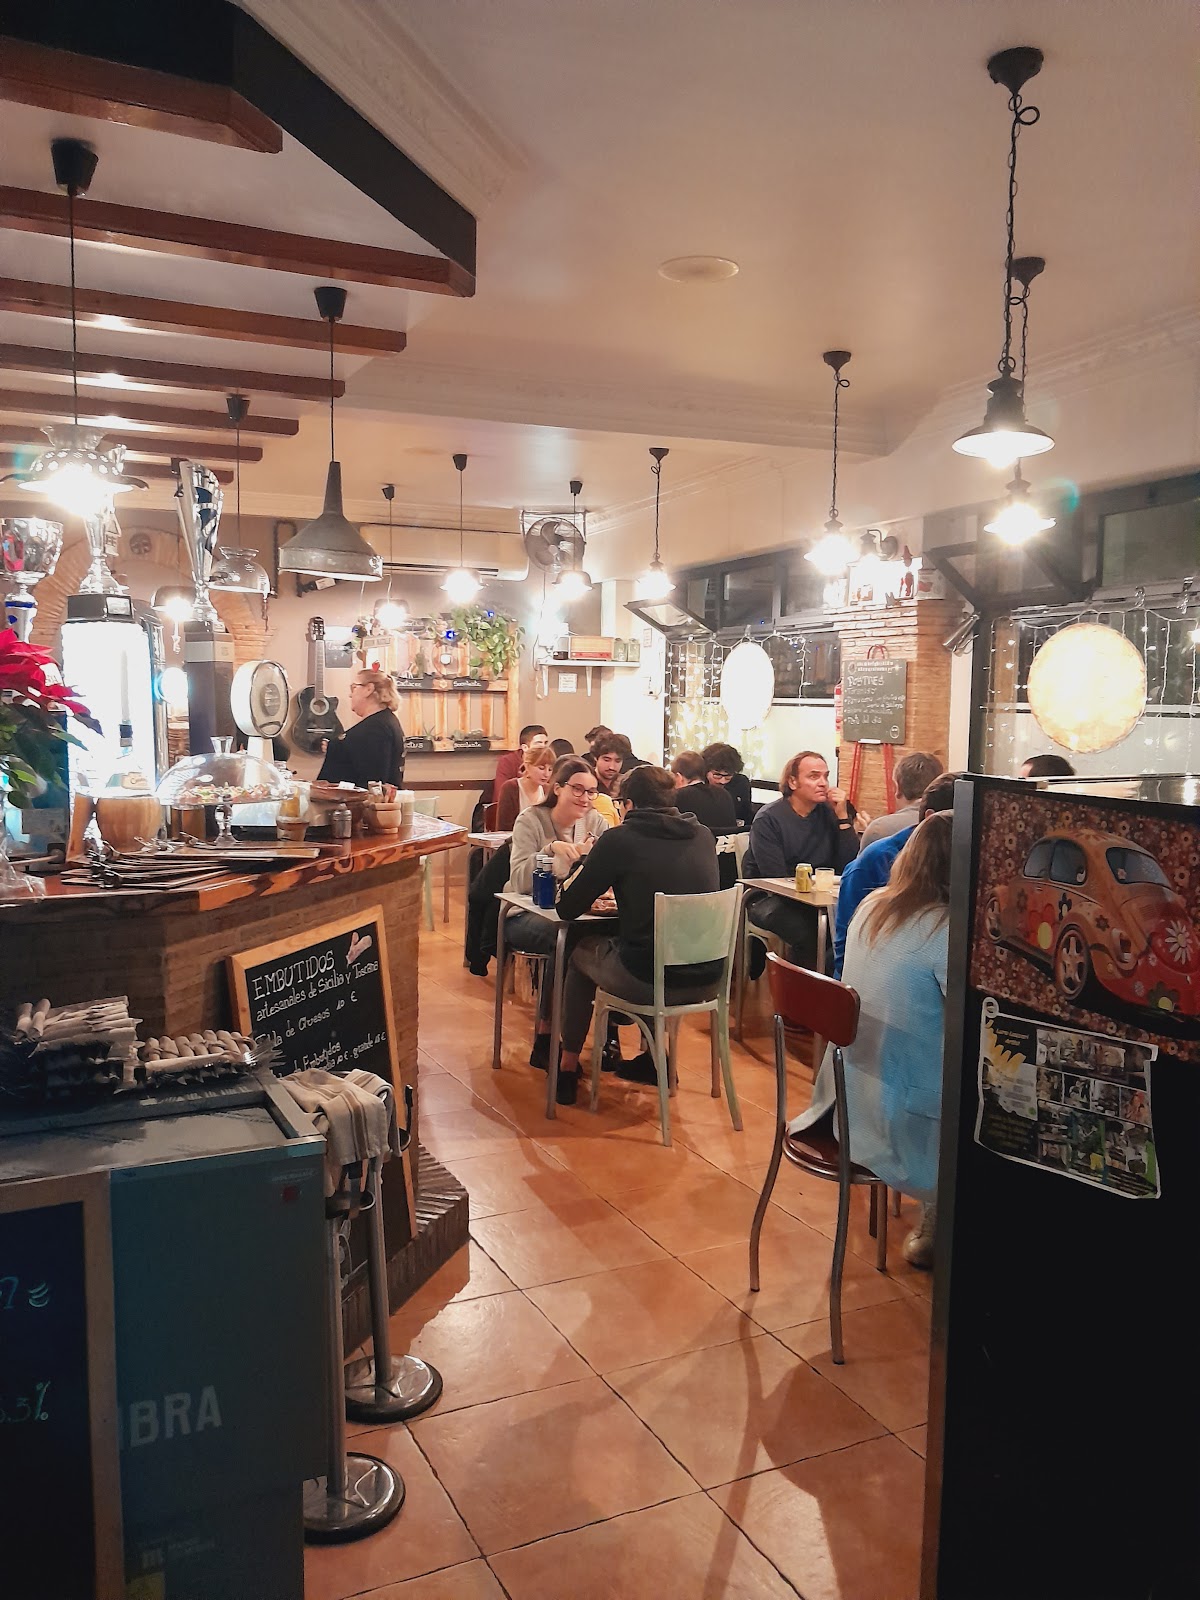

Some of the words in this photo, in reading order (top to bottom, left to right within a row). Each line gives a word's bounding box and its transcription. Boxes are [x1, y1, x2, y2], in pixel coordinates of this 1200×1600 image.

[252, 950, 335, 1000] EMBUTIDOS
[256, 990, 306, 1022] artesanales
[308, 983, 318, 999] de
[318, 970, 345, 993] Sicilia
[343, 971, 351, 985] y
[352, 961, 379, 979] Toscana
[285, 1020, 296, 1038] de
[298, 1008, 331, 1031] Quesos
[350, 991, 358, 1003] €
